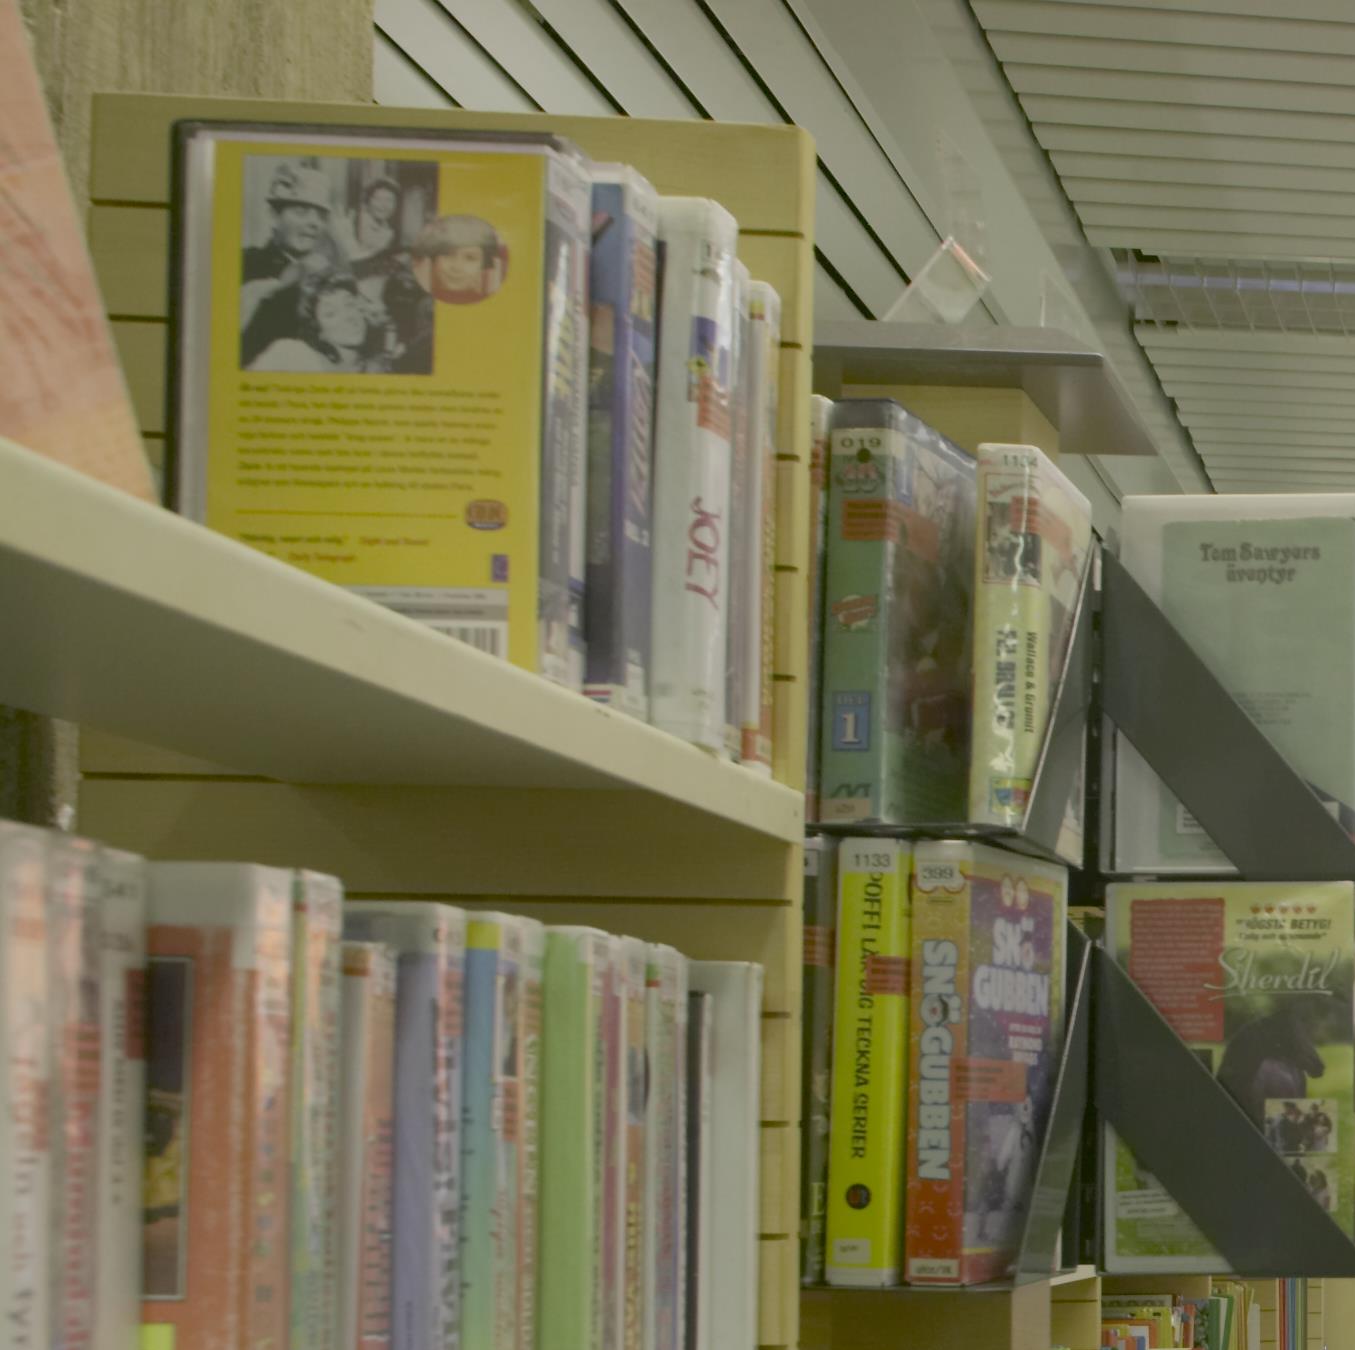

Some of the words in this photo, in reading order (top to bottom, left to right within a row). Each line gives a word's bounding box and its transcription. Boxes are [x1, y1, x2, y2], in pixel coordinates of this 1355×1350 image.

[684, 495, 722, 609] JOEY
[1198, 542, 1238, 563] Tom
[1239, 541, 1321, 564] Sawyers
[1024, 631, 1038, 676] Wallace
[1024, 680, 1037, 690] &
[841, 711, 861, 744] 1
[1023, 693, 1037, 734] Gromit
[854, 852, 891, 868] 1133
[922, 866, 955, 881] 399
[972, 965, 1049, 1018] GUBBEN
[1203, 946, 1341, 997] Sherdil
[853, 1016, 873, 1089] TECKNA
[917, 938, 961, 1181] SNÖGUBBEN
[850, 1092, 869, 1159] SERIER
